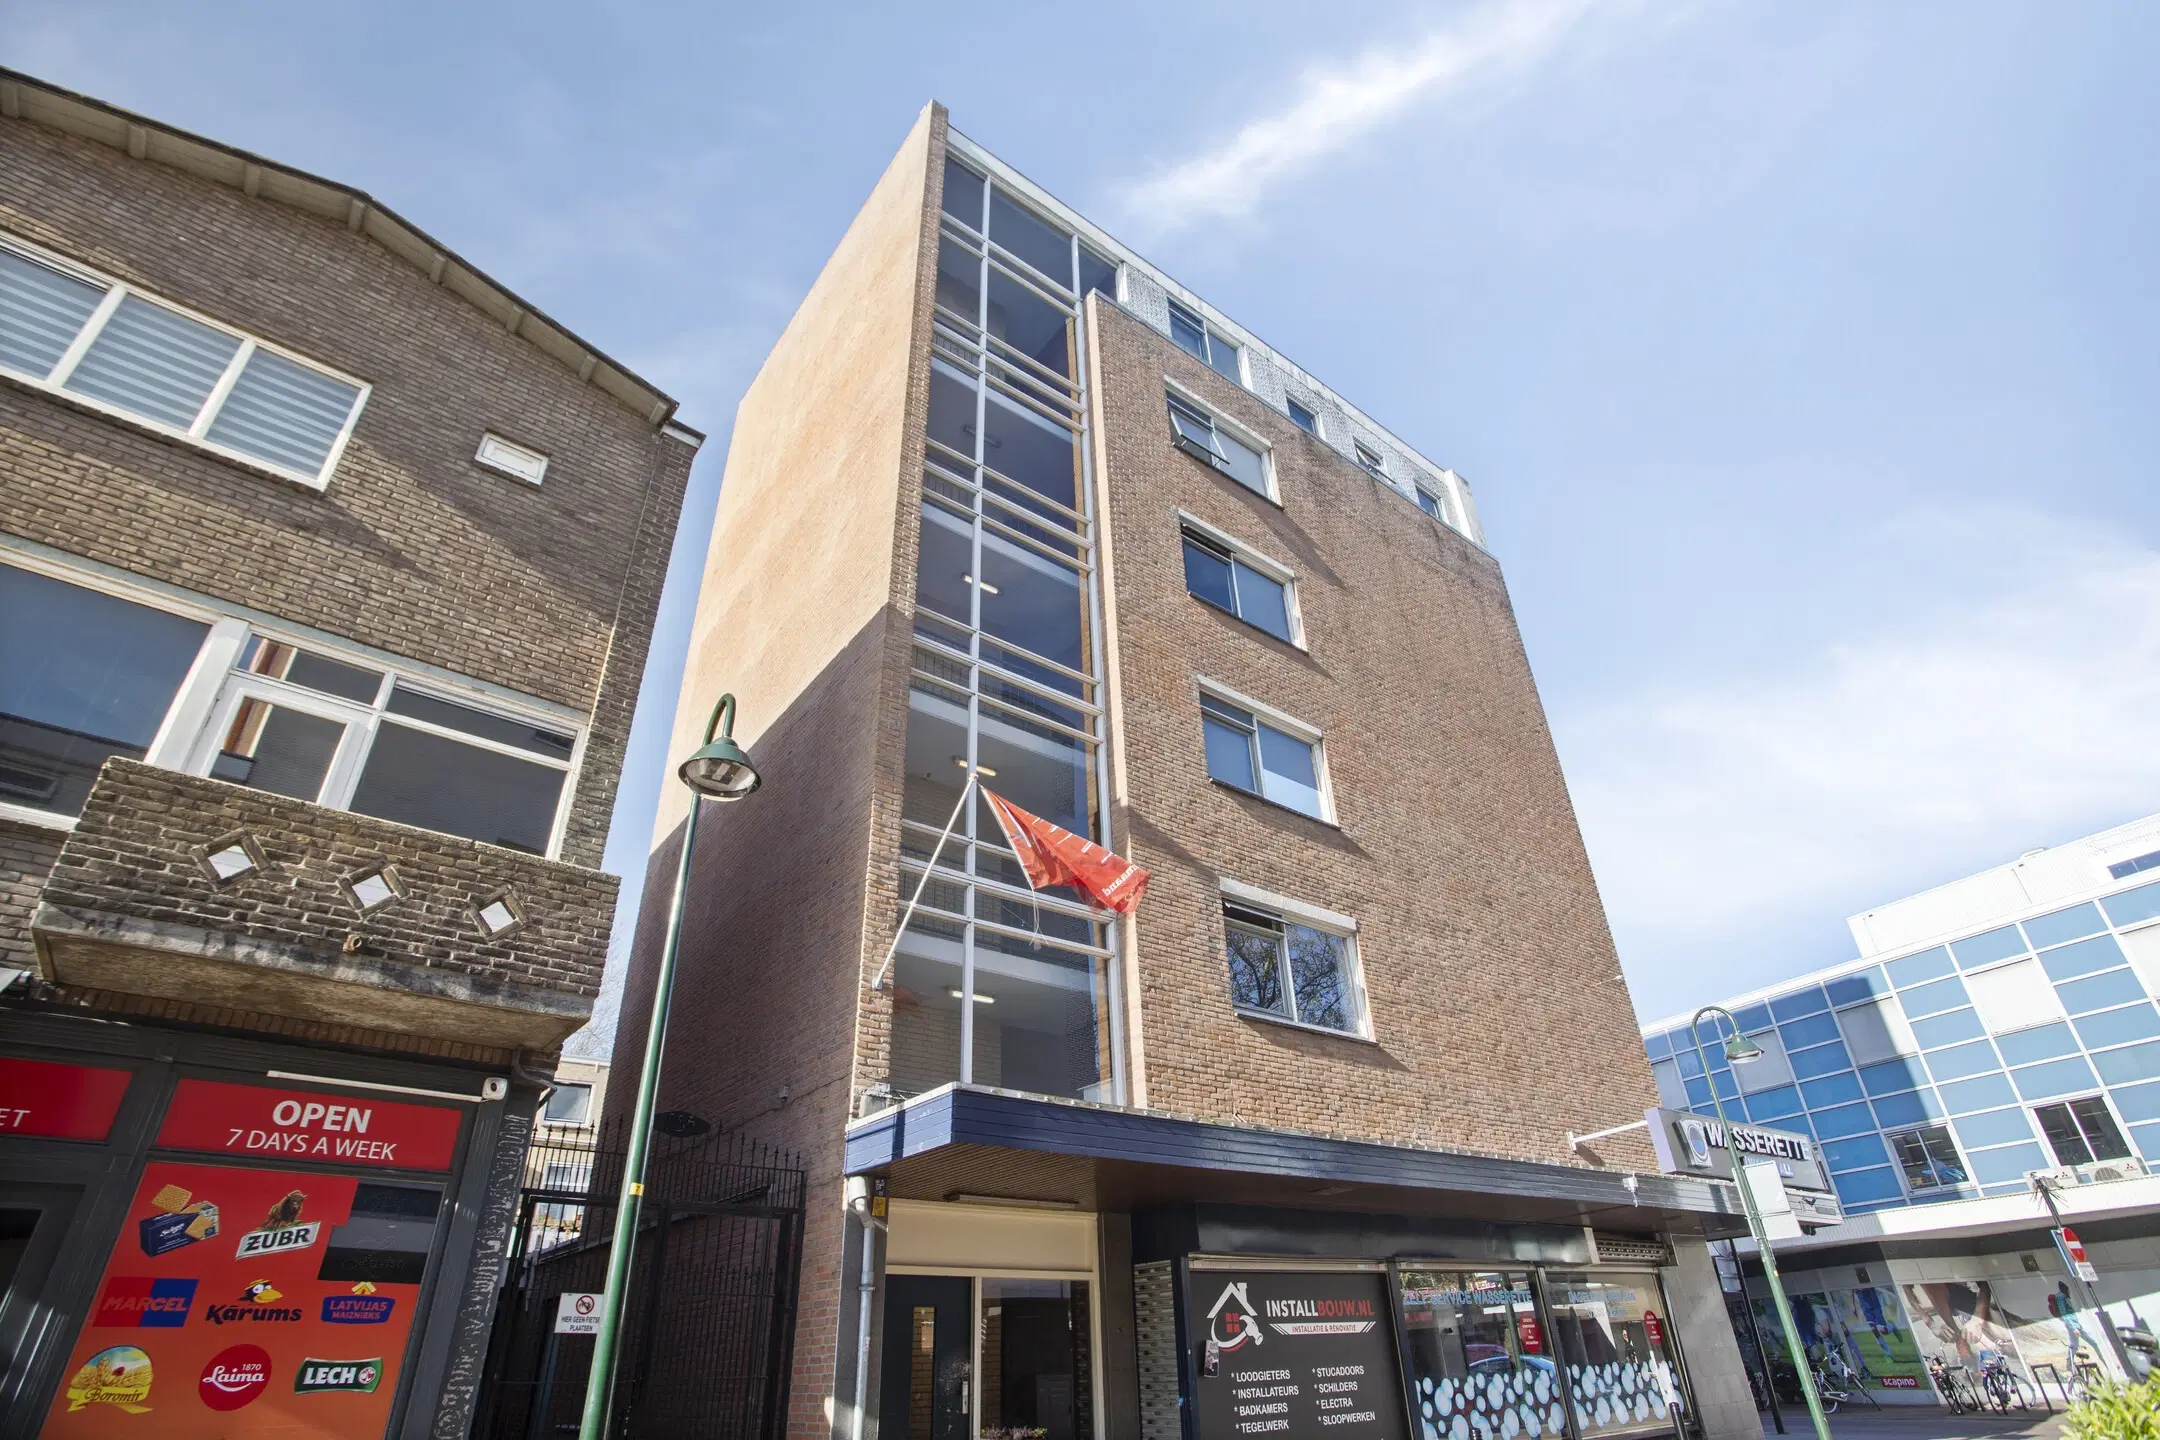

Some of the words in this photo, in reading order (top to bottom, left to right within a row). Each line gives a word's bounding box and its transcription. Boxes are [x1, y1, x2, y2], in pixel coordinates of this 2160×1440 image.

[273, 1100, 372, 1133] OPEN
[226, 1128, 243, 1147] 7
[246, 1130, 309, 1153] DAYS
[312, 1136, 328, 1155] A
[336, 1138, 397, 1160] WEEK
[1704, 1121, 1812, 1161] WSSERETTE
[102, 1296, 188, 1311] MARCEL
[1431, 1290, 1473, 1305] SERVICE
[1473, 1290, 1532, 1305] WASSERETTE
[330, 1299, 388, 1311] LATVIJAS
[1266, 1299, 1375, 1317] INSTALLBOUW.NL
[204, 1304, 303, 1325] Kārums
[561, 1315, 572, 1324] HIER
[586, 1316, 601, 1324] FIETSE
[1292, 1325, 1324, 1333] INSTALLATIE
[1329, 1324, 1357, 1333] RENOVATIE
[242, 1363, 262, 1371] 1870
[1317, 1365, 1364, 1377] STUCADOORS
[202, 1365, 265, 1392] Laima
[302, 1367, 356, 1385] LECH
[1236, 1369, 1291, 1382] LOODGIETERS
[1318, 1381, 1358, 1393] SCHILDERS
[1883, 1378, 1915, 1389] scapino
[85, 1388, 143, 1402] Boromir
[1237, 1385, 1299, 1399] INSTALLATEURS
[1239, 1402, 1288, 1416] BADKAMERS
[1321, 1397, 1353, 1409] ELECTRA
[1322, 1411, 1376, 1425] SLOOPWERKEN
[1240, 1419, 1289, 1433] TEGELWERK
